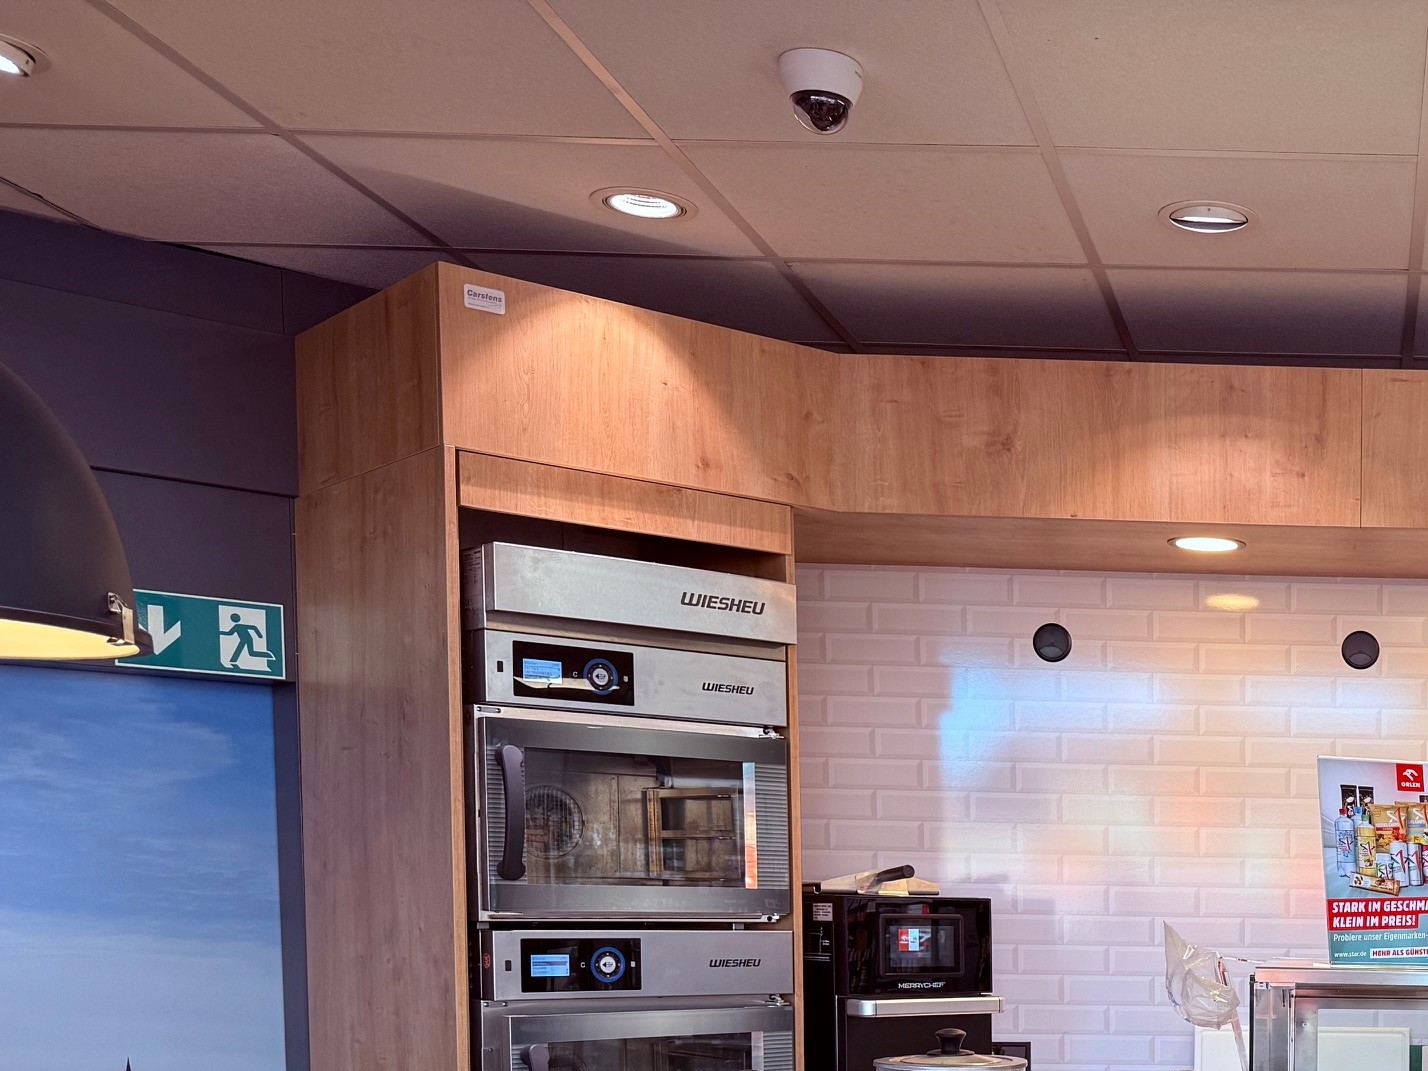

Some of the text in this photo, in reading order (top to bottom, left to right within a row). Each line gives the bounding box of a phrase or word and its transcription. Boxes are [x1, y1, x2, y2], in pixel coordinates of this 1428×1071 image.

[467, 289, 503, 303] Carstens
[680, 591, 766, 615] WIESHEU
[701, 681, 755, 696] WIESHEU
[1332, 901, 1366, 914] STARK
[1368, 901, 1381, 913] IM
[1333, 914, 1416, 928] KLEIN IM PREIS!
[1333, 933, 1362, 942] Probiere
[1363, 933, 1382, 941] unser
[1372, 949, 1391, 957] MEHR
[708, 957, 762, 969] WIESHEU
[898, 981, 946, 989] MERRYCHEF
